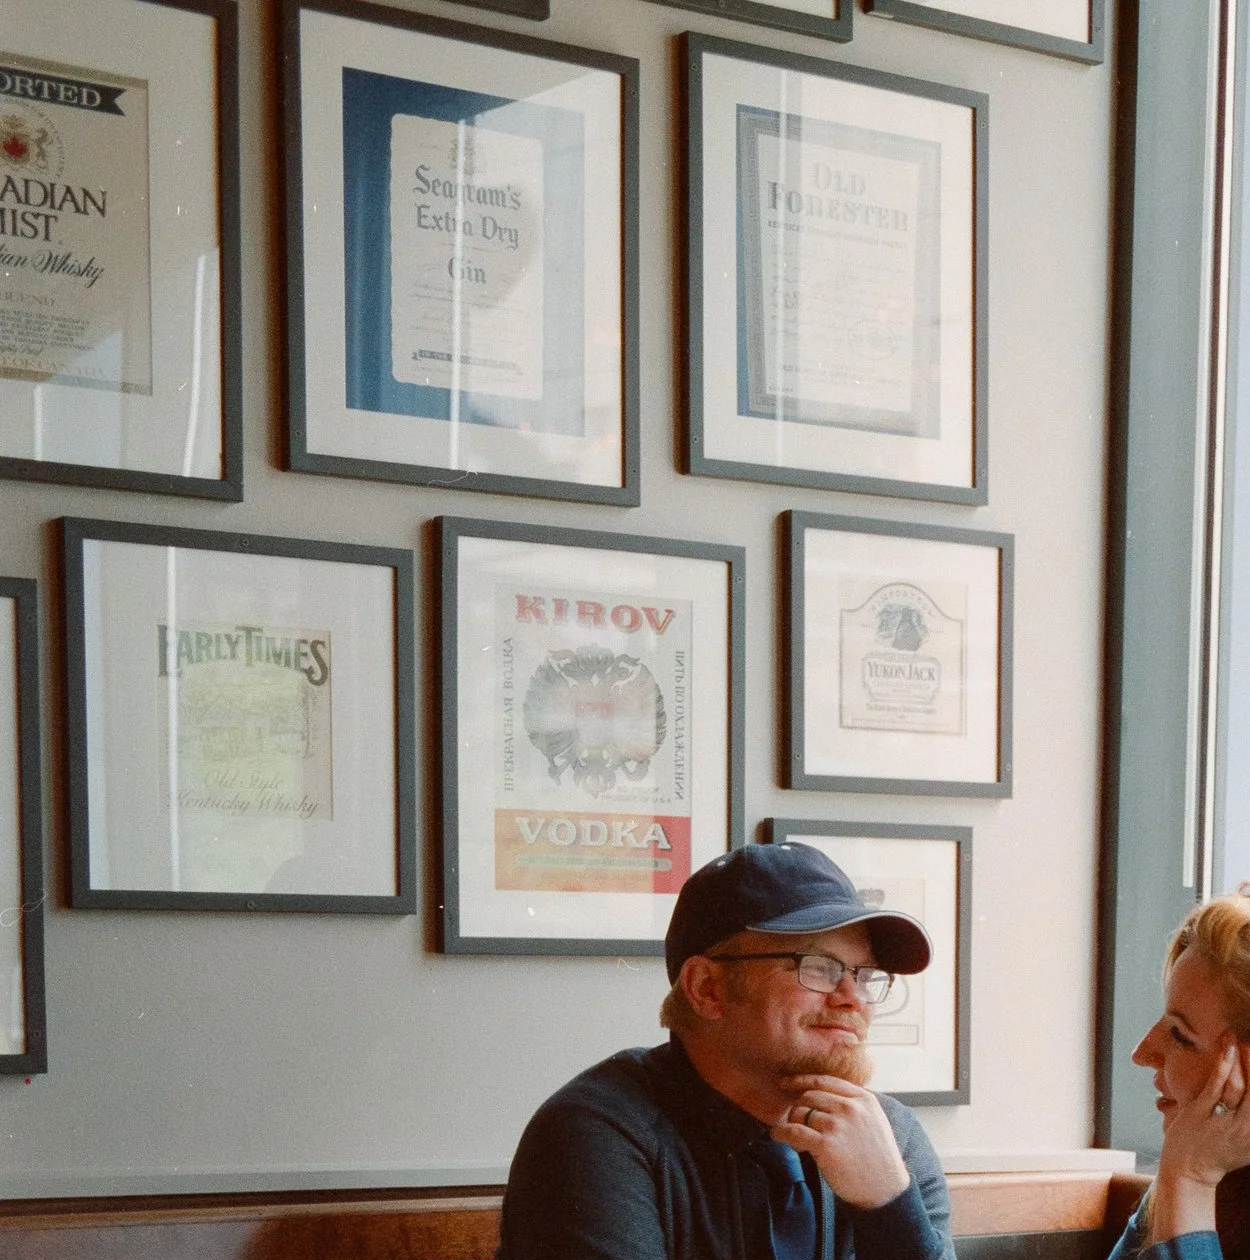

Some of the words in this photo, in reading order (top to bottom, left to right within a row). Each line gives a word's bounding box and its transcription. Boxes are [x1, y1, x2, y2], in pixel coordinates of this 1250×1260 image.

[813, 161, 867, 197] OLD
[767, 181, 909, 231] FORESTER
[481, 215, 519, 251] Dry
[0, 243, 28, 268] ian
[31, 249, 104, 289] Whisky
[447, 256, 487, 285] Gin
[514, 594, 676, 635] KIROV
[235, 625, 328, 687] TIMES
[516, 816, 672, 850] VODKA
